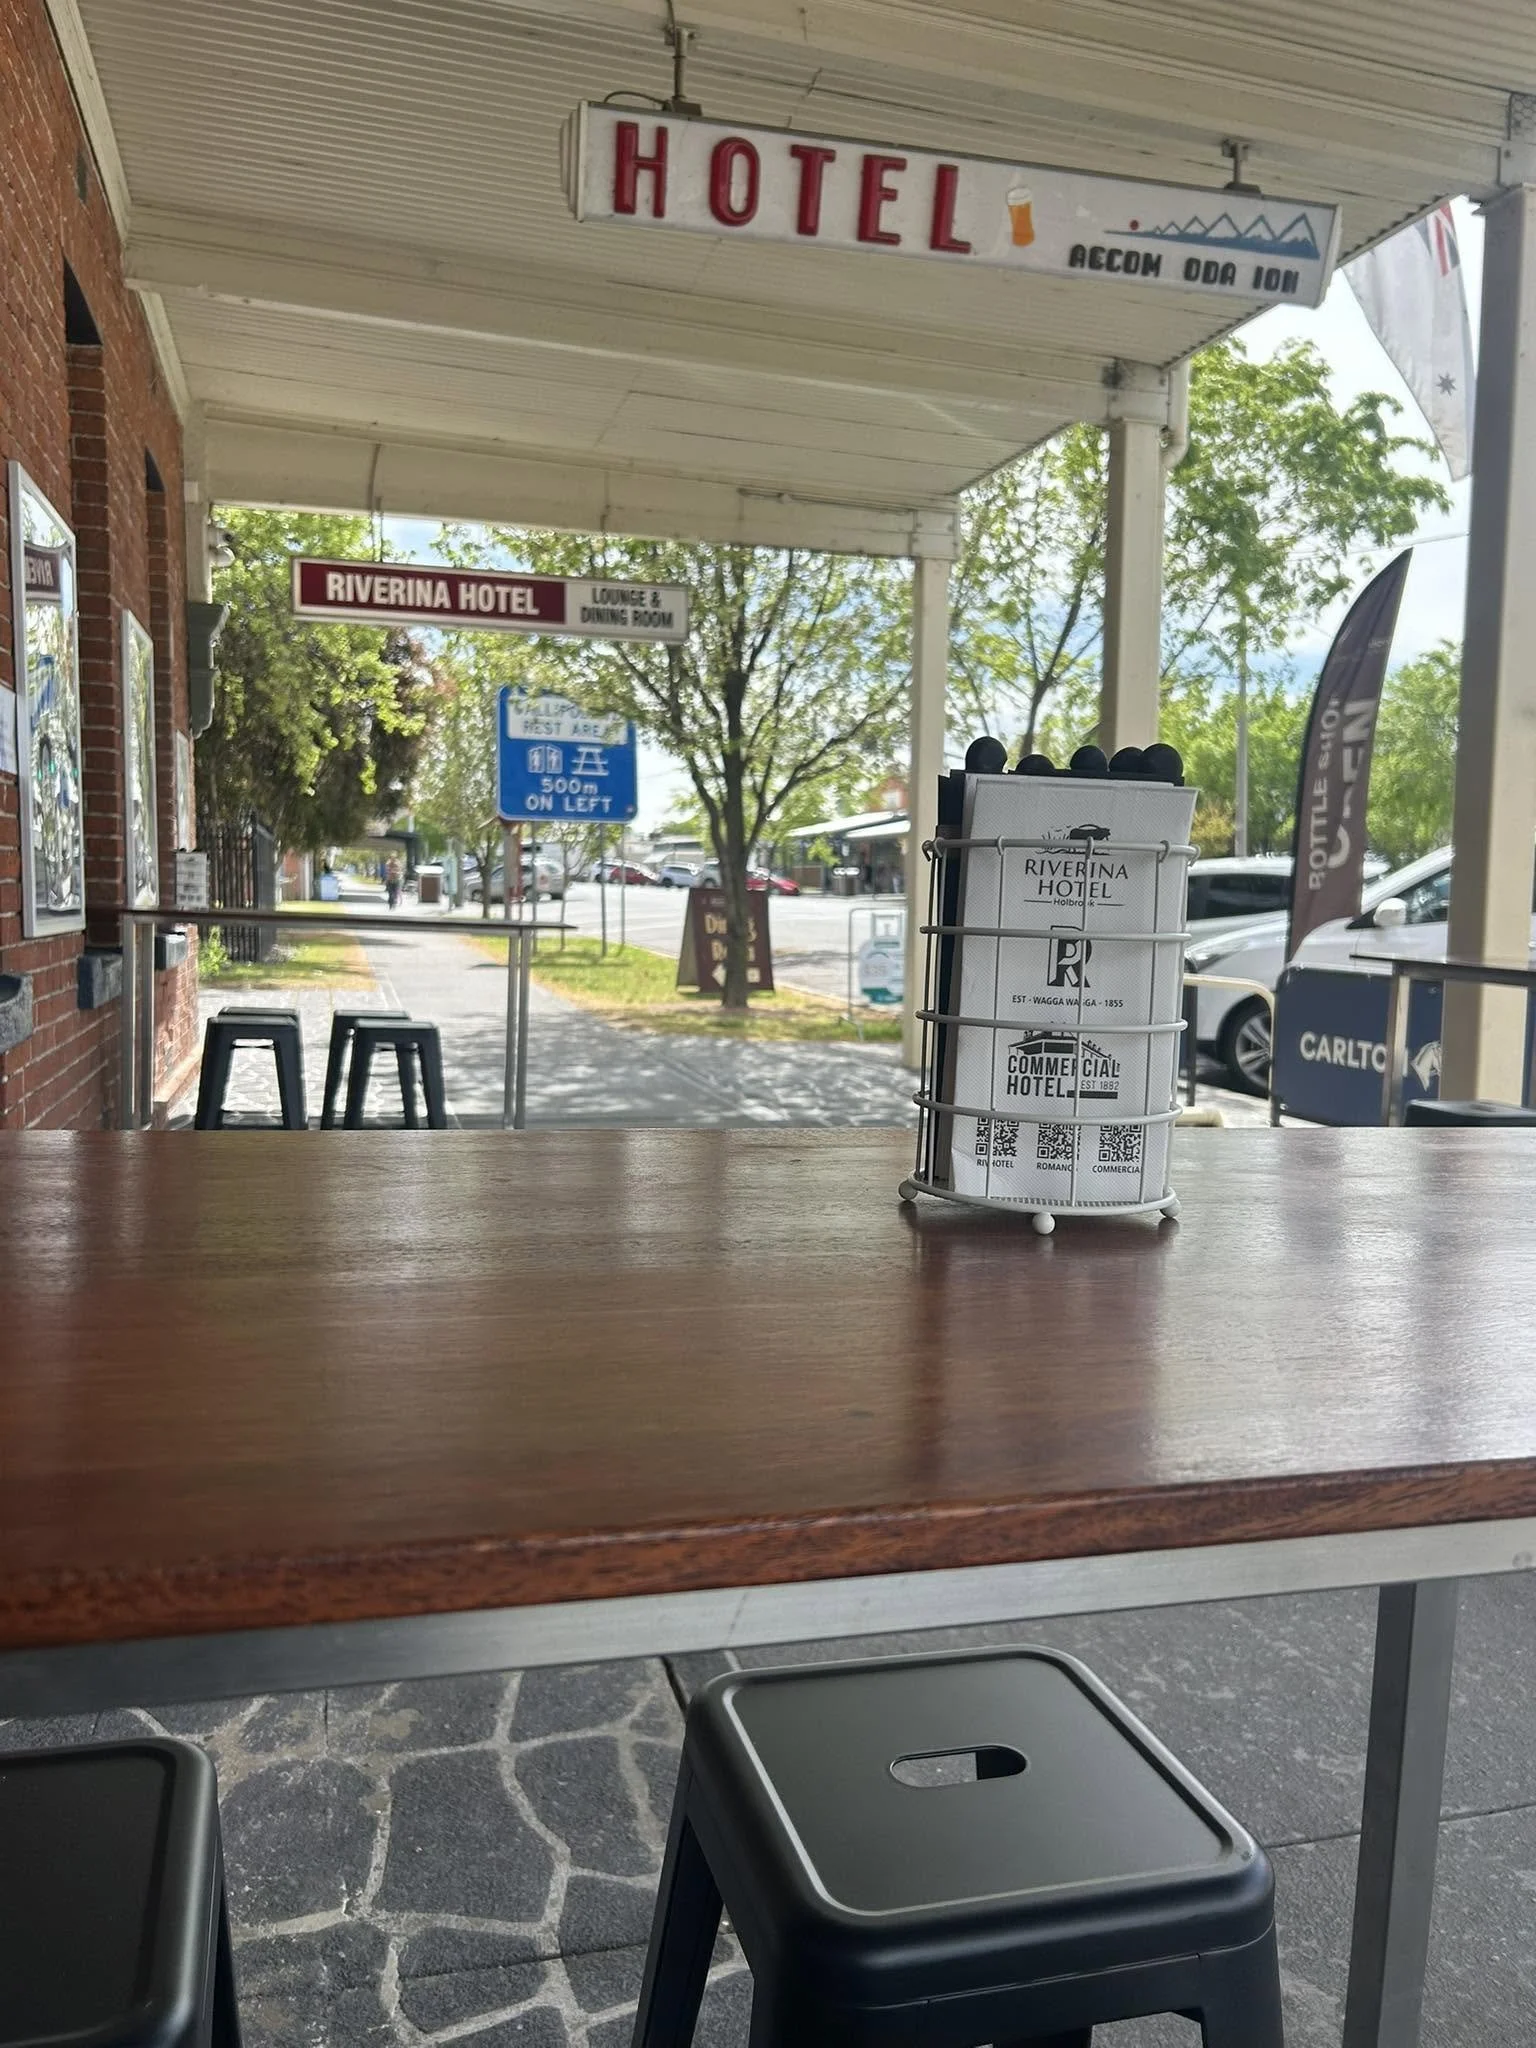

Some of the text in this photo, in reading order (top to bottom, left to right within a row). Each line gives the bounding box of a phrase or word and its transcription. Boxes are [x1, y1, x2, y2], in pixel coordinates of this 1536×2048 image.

[613, 121, 971, 254] HOTEL
[325, 571, 540, 616] RIVERINA HOTEL
[591, 587, 661, 608] LOUNGE &
[580, 605, 674, 628] DINING ROOM
[523, 719, 561, 735] REST
[541, 776, 598, 795] 500m
[525, 793, 612, 813] ON LEFT
[1025, 859, 1128, 879] RIVERINA
[1038, 880, 1112, 898] HOTEL
[1053, 899, 1095, 907] Holbrok
[1012, 995, 1026, 1003] EST
[1033, 996, 1064, 1006] WAGGA
[1065, 998, 1097, 1007] WAGA
[1105, 999, 1124, 1008] 1855
[1007, 1075, 1065, 1098] HOTEL
[1081, 1080, 1096, 1090] EST
